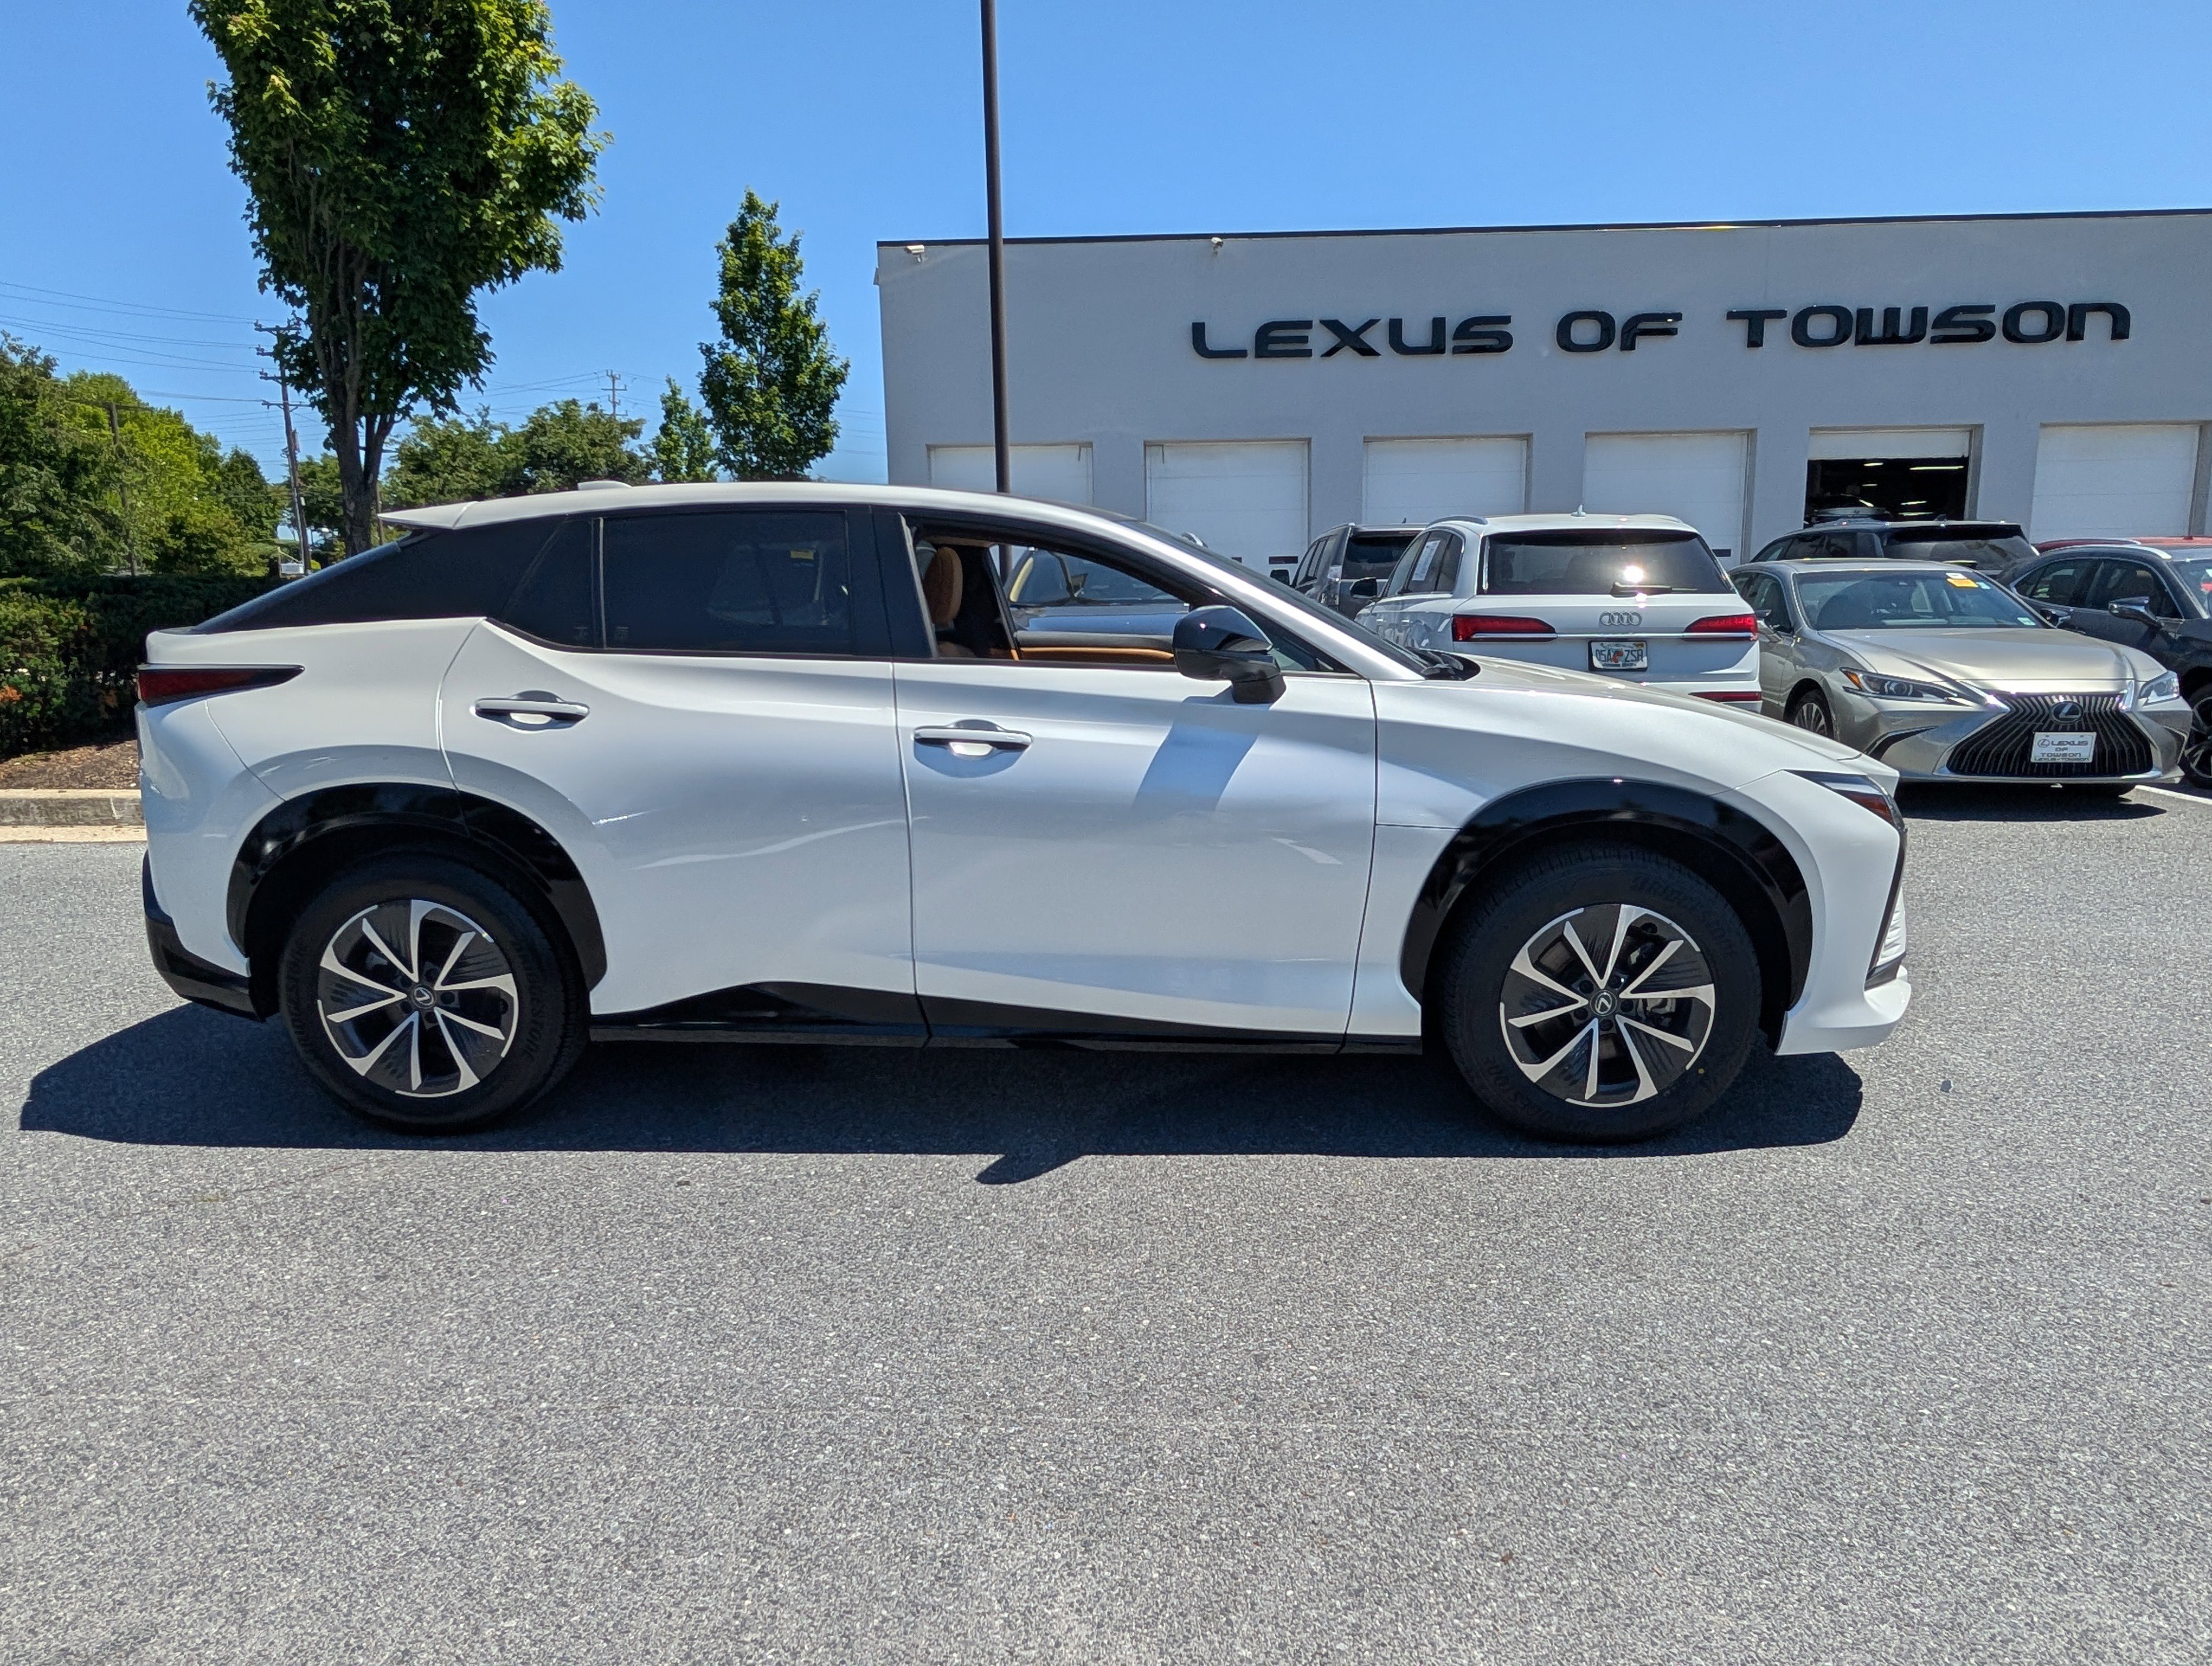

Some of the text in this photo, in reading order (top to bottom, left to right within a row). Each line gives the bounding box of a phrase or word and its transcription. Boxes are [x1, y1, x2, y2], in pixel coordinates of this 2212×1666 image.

[1192, 300, 2131, 359] LEXUS OF TOWSON
